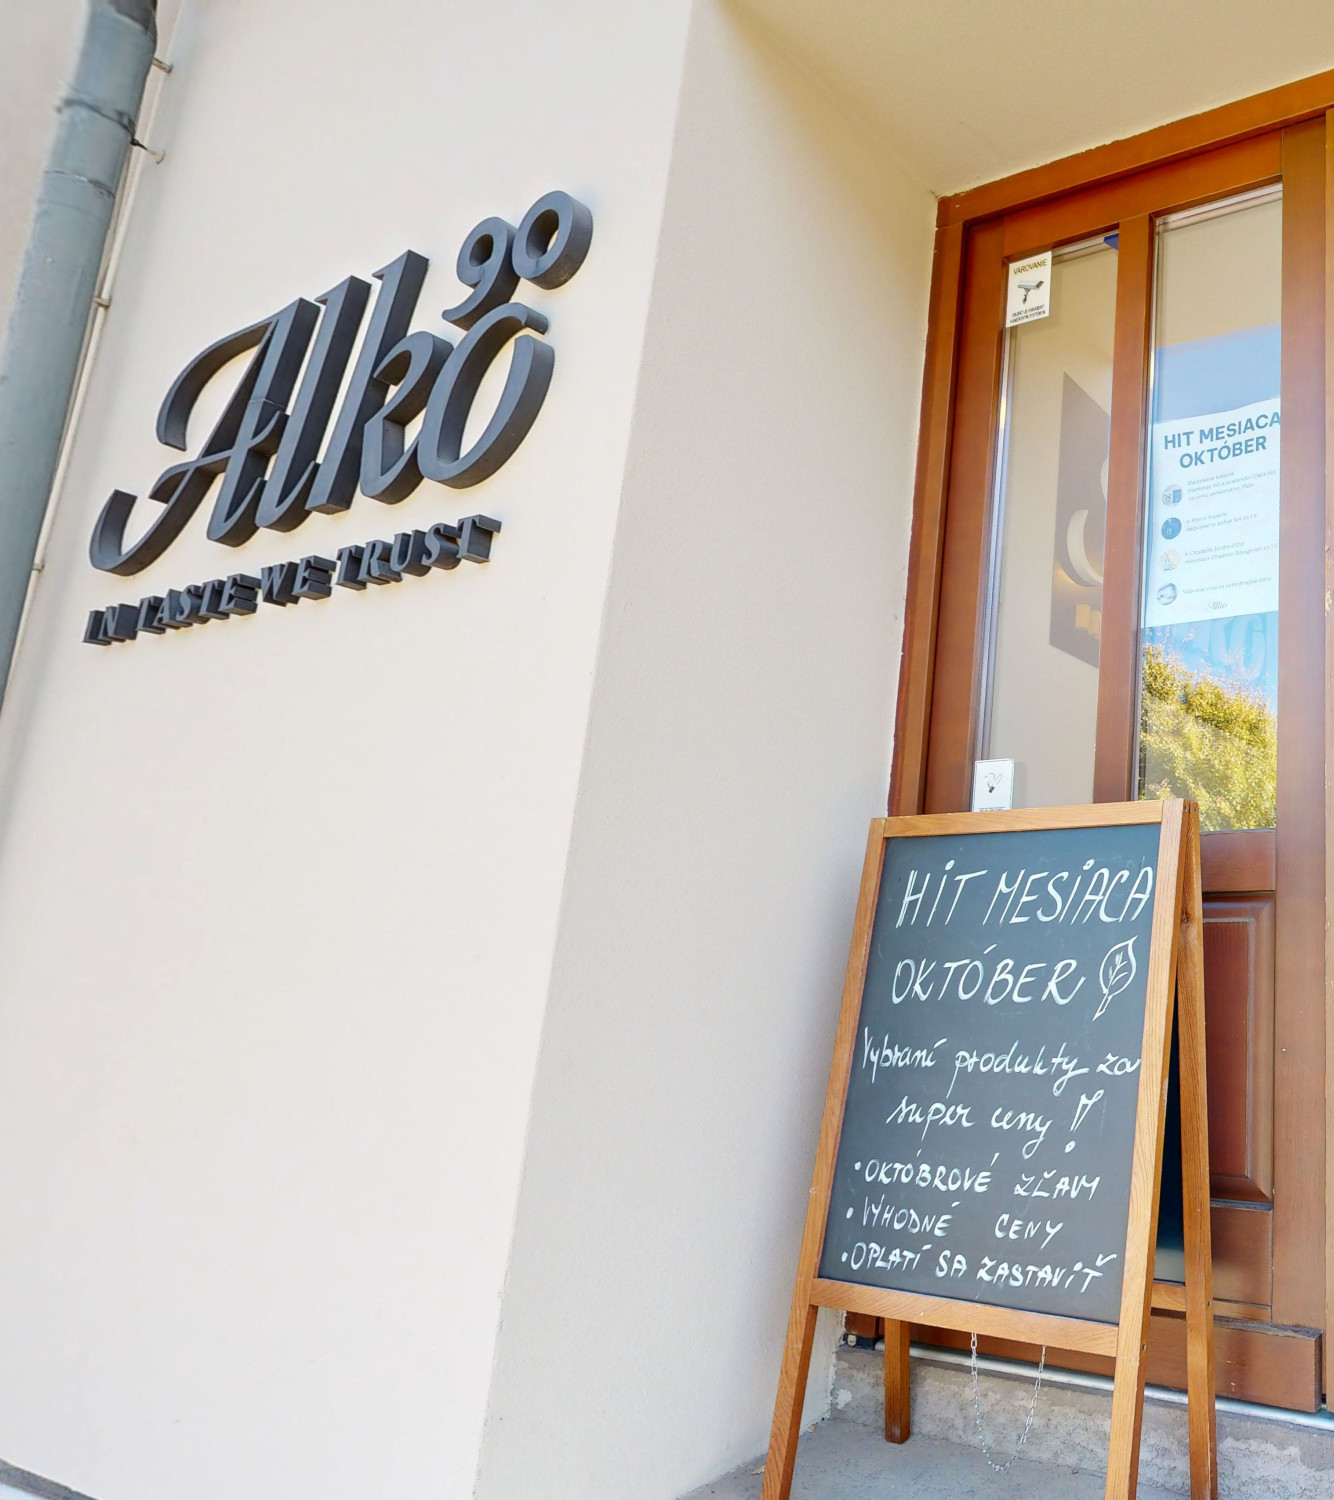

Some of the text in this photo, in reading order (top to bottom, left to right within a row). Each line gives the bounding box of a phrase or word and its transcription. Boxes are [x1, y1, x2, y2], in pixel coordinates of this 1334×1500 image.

[1013, 258, 1047, 275] VAROVANIE
[1164, 411, 1280, 450] HIT MESIACA
[1179, 435, 1267, 469] OKTÓBER
[83, 514, 502, 646] IN TASTE WE TRUST
[890, 943, 1087, 1007] OKTÓBER
[946, 1039, 1090, 1098] produkty
[1095, 1051, 1142, 1076] za
[885, 1095, 975, 1142] super
[994, 1213, 1064, 1250] CENY
[935, 1249, 968, 1280] SA
